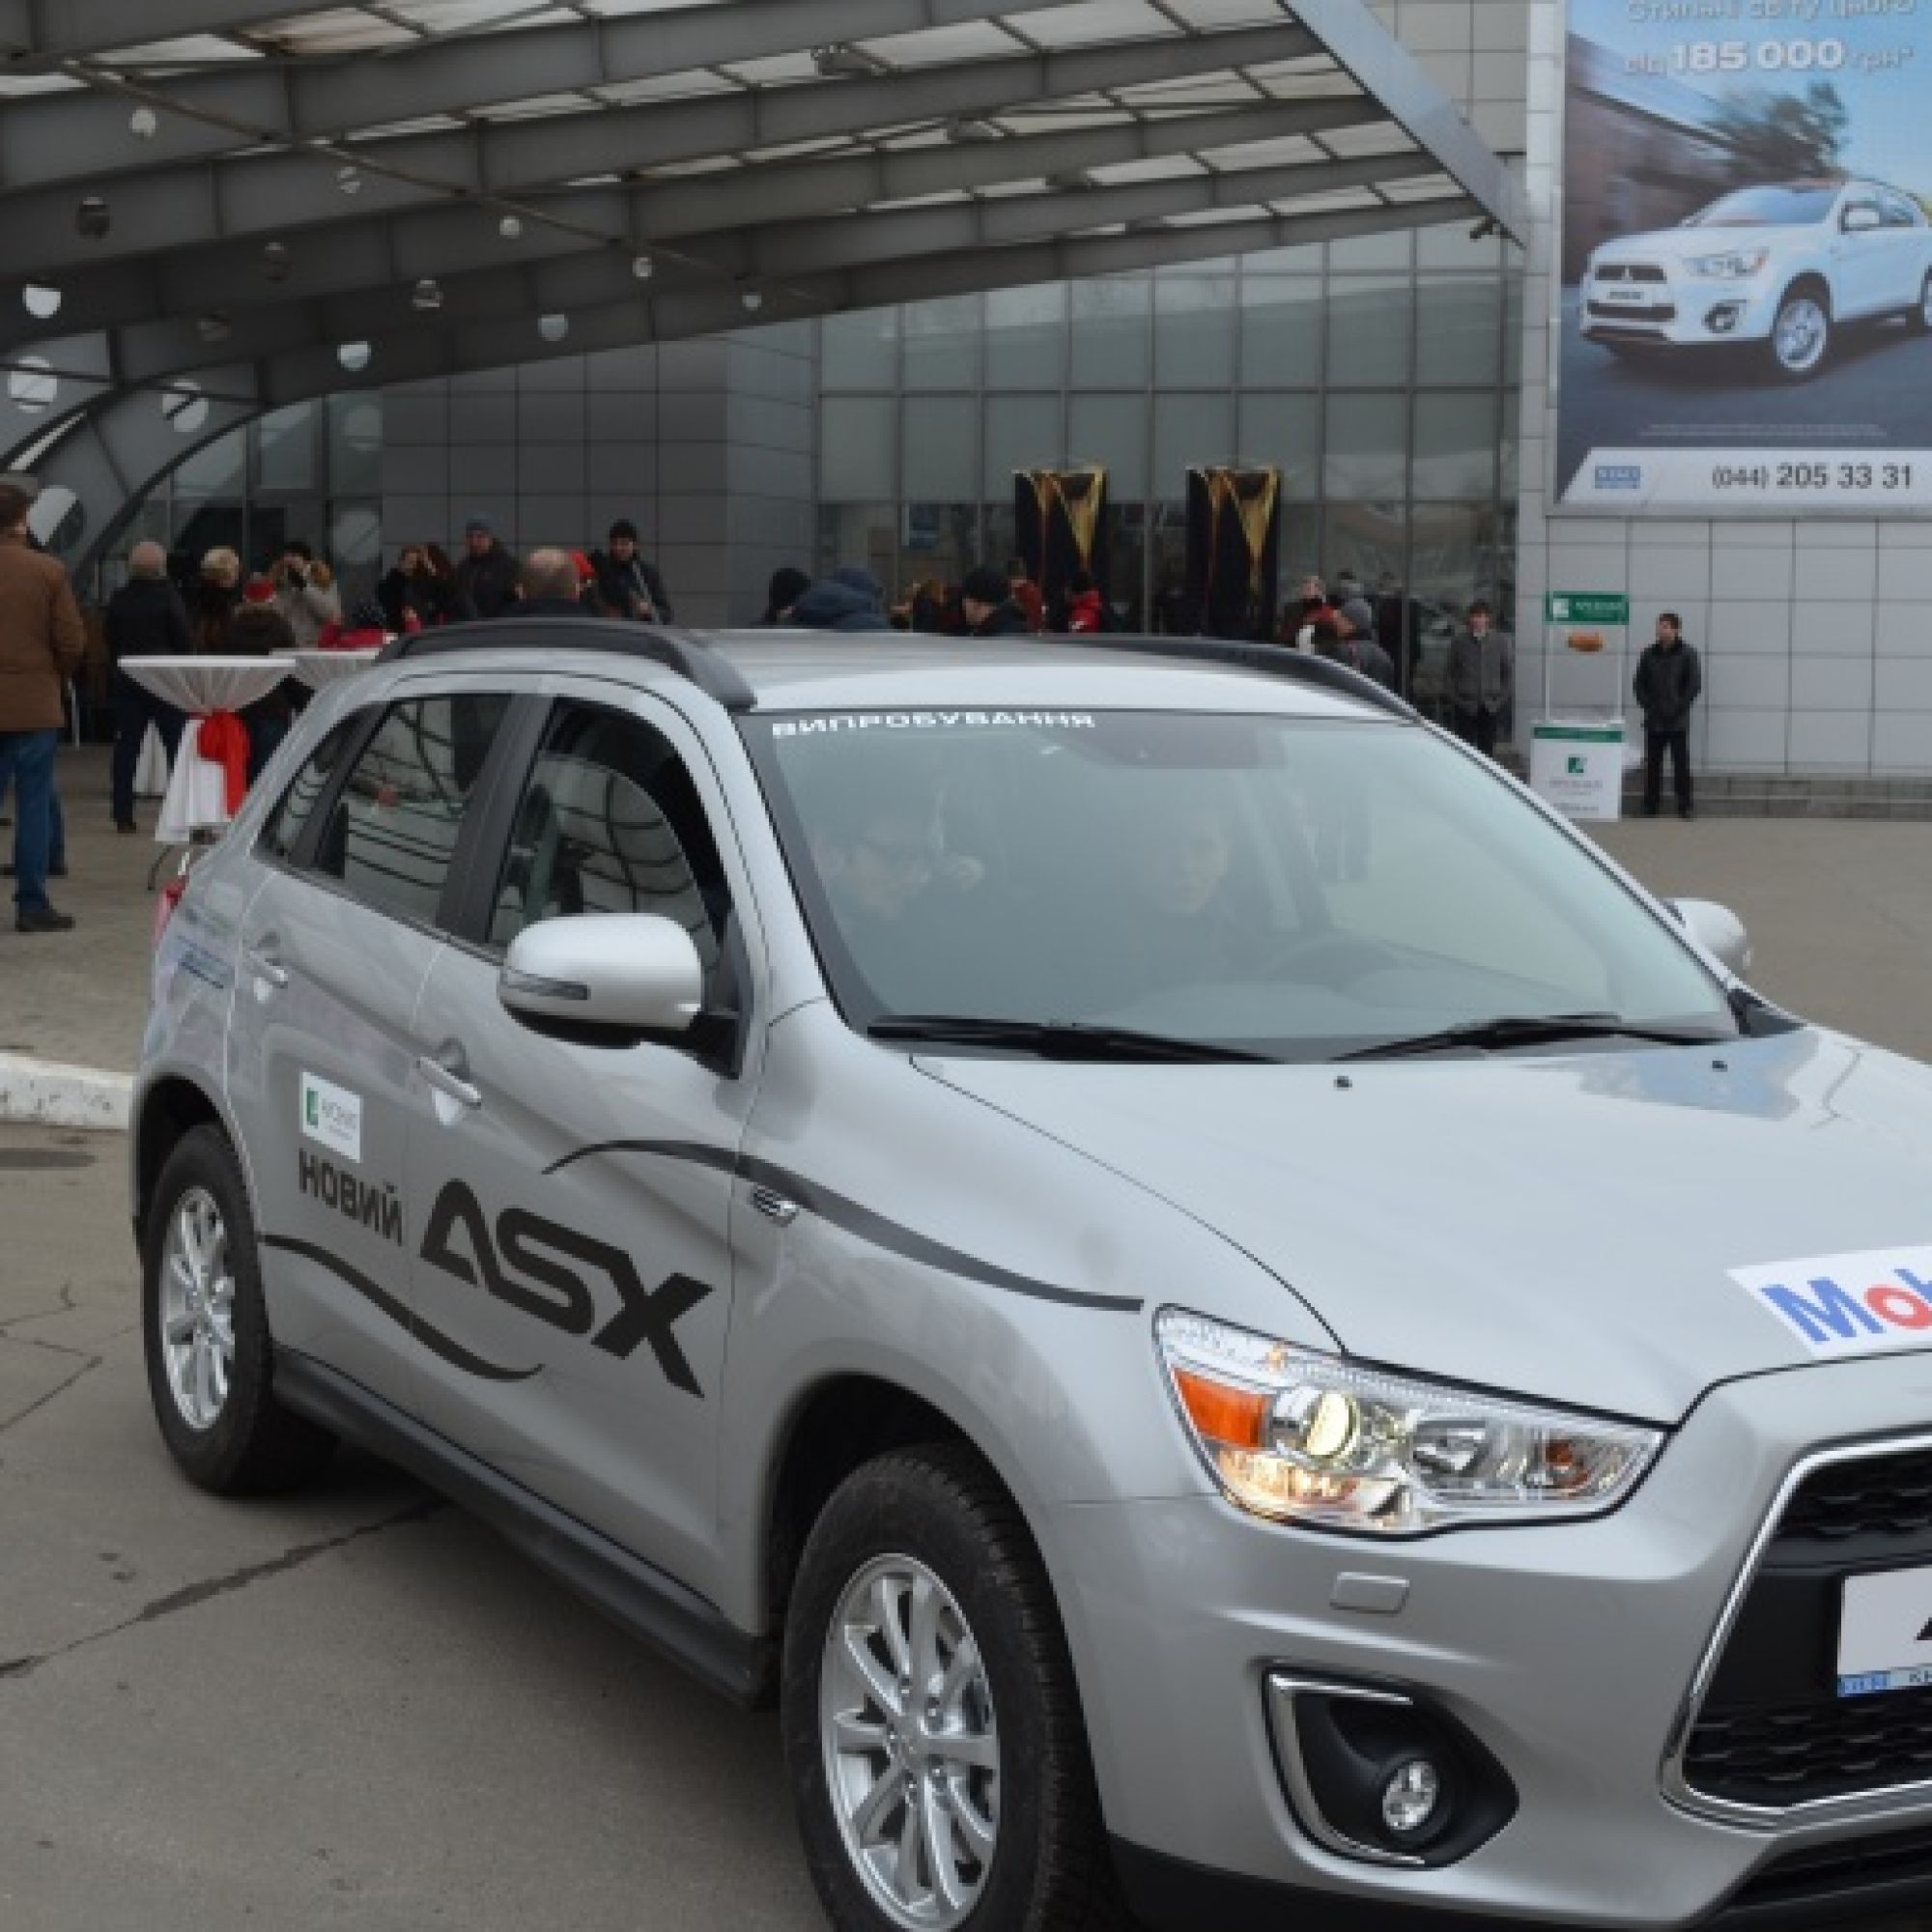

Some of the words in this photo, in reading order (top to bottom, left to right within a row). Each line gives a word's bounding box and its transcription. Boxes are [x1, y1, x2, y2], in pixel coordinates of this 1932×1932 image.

[1672, 41, 1747, 70] 185
[1757, 40, 1843, 70] 000
[1712, 465, 1769, 489] (044)
[1776, 462, 1830, 489] 205
[1836, 462, 1873, 489] 33
[1883, 462, 1912, 489] 31
[772, 711, 1096, 737] ВИПРОБУВАННЯ
[298, 1147, 403, 1247] НОВИЙ
[420, 1179, 716, 1399] ASX
